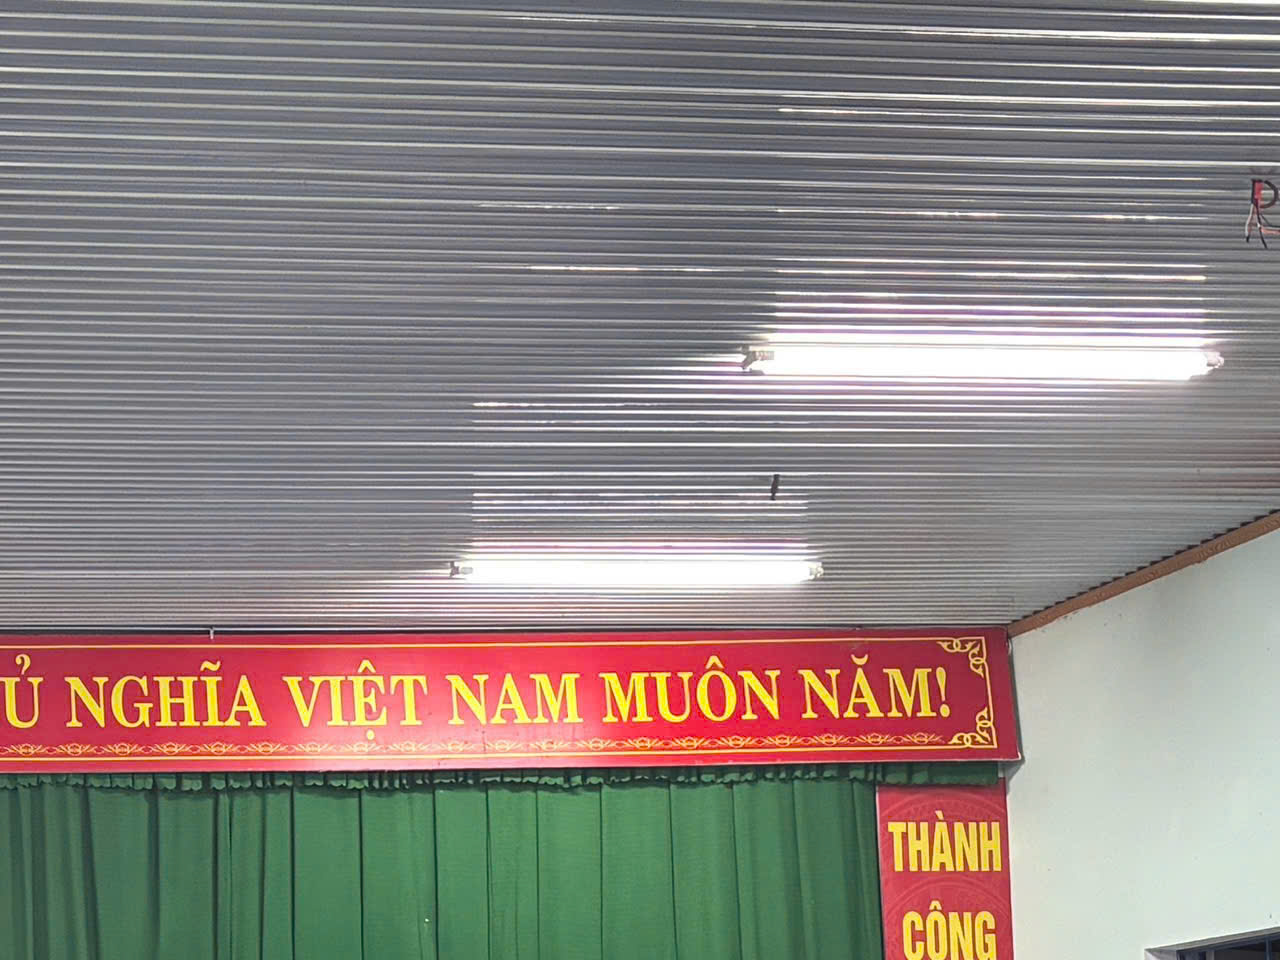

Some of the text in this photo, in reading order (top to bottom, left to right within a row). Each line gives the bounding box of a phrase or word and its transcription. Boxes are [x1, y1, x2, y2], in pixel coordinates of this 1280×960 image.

[64, 660, 268, 729] NGHĨA
[282, 659, 428, 741] VIỆT
[445, 672, 584, 725] NAM
[598, 655, 781, 723] MUÔN
[797, 653, 952, 719] NĂM!
[887, 810, 1002, 872] THÀNH
